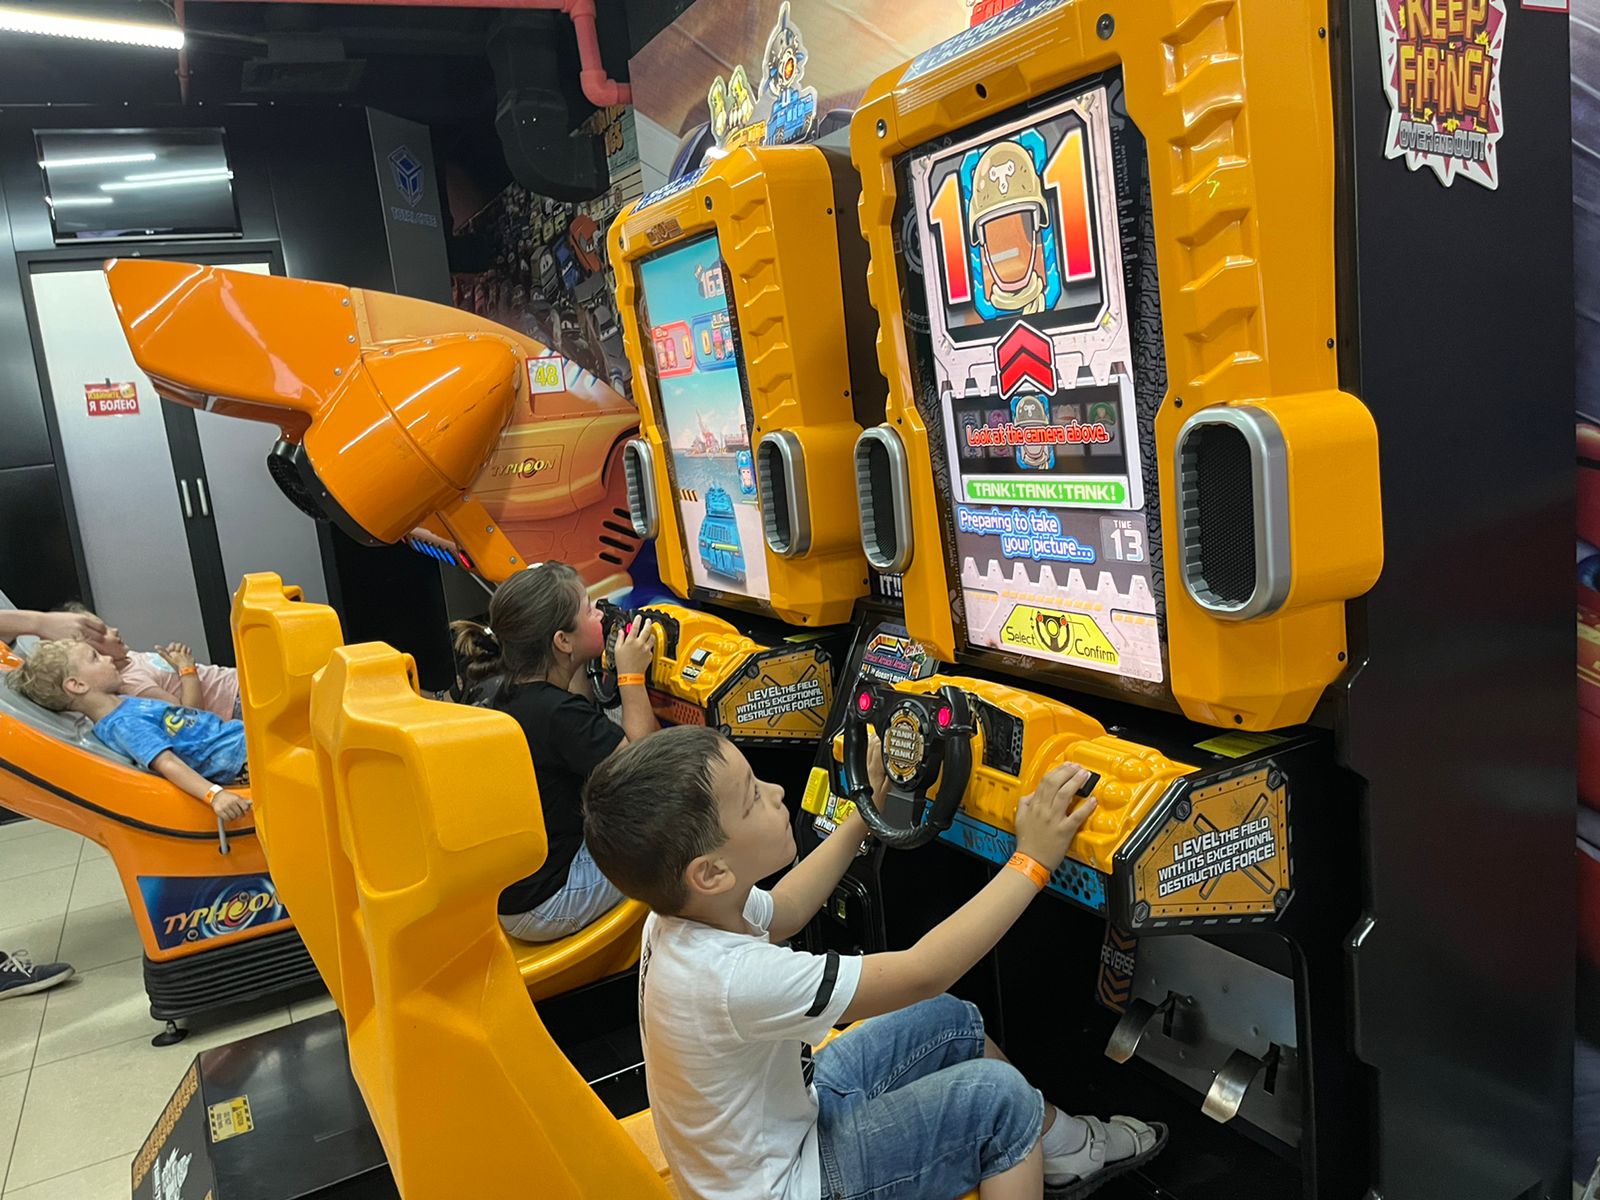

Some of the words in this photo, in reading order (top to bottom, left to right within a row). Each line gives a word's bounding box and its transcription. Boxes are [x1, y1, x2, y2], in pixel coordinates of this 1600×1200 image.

[1407, 0, 1488, 42] KEEP
[1400, 121, 1434, 151] OVER
[535, 364, 559, 386] 48
[89, 400, 97, 412] Я
[100, 399, 137, 412] БОЛЕЮ
[966, 425, 992, 446] Look
[993, 424, 1006, 445] at
[1006, 423, 1024, 444] the
[1024, 425, 1067, 444] camera
[1067, 420, 1109, 443] above.
[959, 509, 1012, 533] Preparing
[1014, 511, 1029, 531] to
[1031, 510, 1058, 533] take
[1004, 535, 1030, 554] your
[1032, 537, 1092, 559] picture...
[1110, 529, 1144, 562] 13
[1006, 625, 1036, 647] Select
[1074, 638, 1117, 663] Confirm
[736, 702, 757, 714] WITH
[757, 699, 771, 709] ITS
[771, 687, 823, 706] EXCEPTIONAL
[747, 687, 781, 702] LEVEL
[780, 684, 796, 695] THE
[797, 680, 819, 690] FIELD
[737, 704, 791, 723] DESTRUCTIVE
[791, 696, 824, 711] FORCE!
[890, 738, 915, 750] TANK!
[891, 729, 917, 740] TANK!
[889, 748, 914, 760] TANK!
[1173, 832, 1220, 861] LEVEL
[1220, 827, 1240, 844] THE
[1241, 817, 1269, 837] FIELD
[1158, 860, 1186, 881] WITH
[1187, 855, 1205, 871] ITS
[1206, 831, 1274, 864] EXCEPTIONAL
[1159, 860, 1232, 896] DESTRUCTIVE
[1232, 844, 1275, 871] FORCE!
[163, 889, 276, 935] TYPHOO
[1101, 944, 1136, 976] REVERSE
